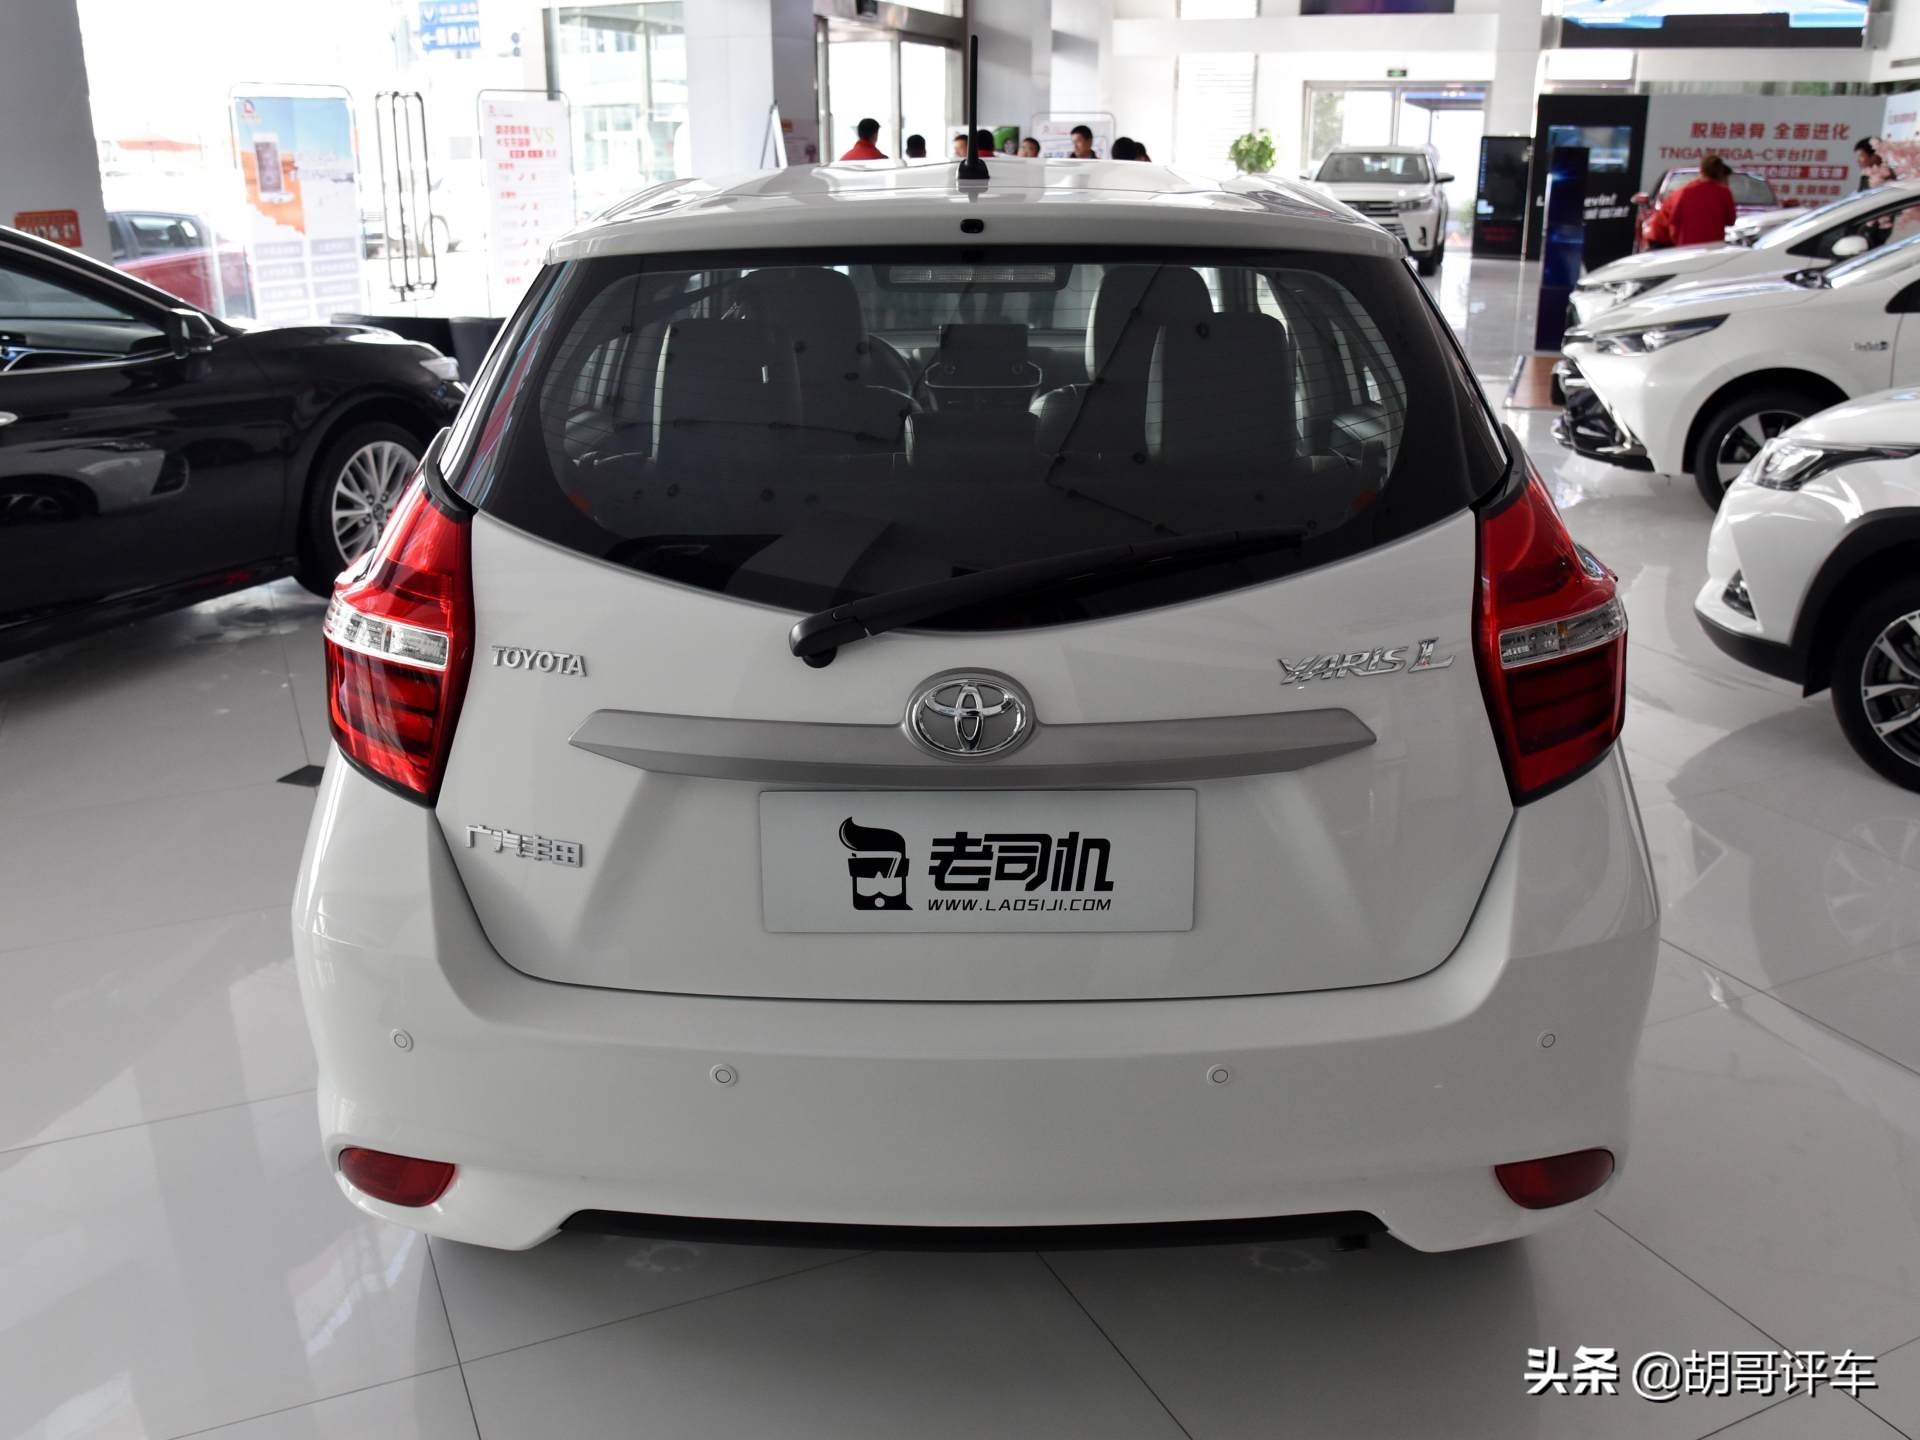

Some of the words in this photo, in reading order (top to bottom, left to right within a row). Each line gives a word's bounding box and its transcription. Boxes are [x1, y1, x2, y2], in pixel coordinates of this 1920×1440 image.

[1690, 122, 1766, 140] 脱胎换骨
[1773, 122, 1850, 141] 全面进化
[491, 645, 588, 677] TOYOTA
[1408, 637, 1455, 672] L
[465, 824, 583, 868] 广汽丰田
[928, 831, 1114, 892] 老司机
[928, 898, 1112, 911] WWW.LAOSIJI.COM
